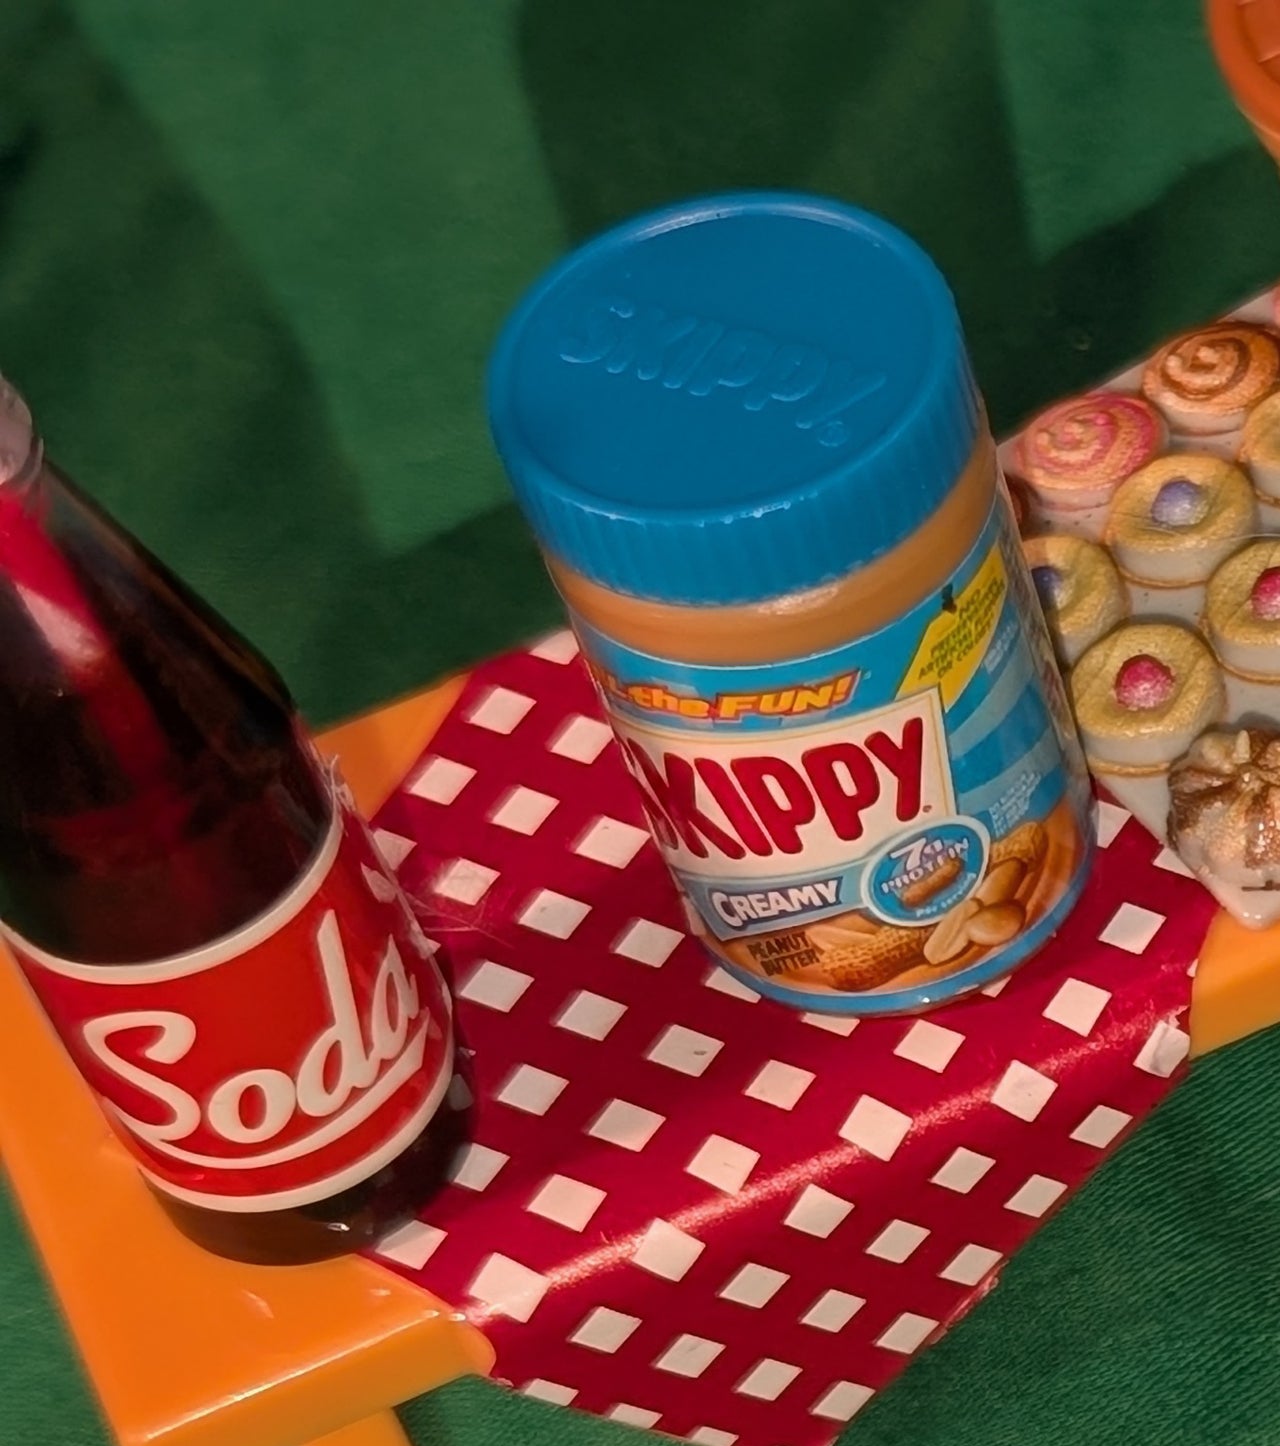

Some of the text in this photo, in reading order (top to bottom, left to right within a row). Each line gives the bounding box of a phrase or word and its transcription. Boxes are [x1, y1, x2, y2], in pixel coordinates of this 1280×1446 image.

[627, 675, 854, 719] the FUN!
[880, 837, 970, 895] PROTEIN
[710, 878, 839, 928] CREAMY
[746, 931, 812, 960] PEANUT
[759, 948, 821, 977] BUTTER
[82, 908, 430, 1169] Soda
